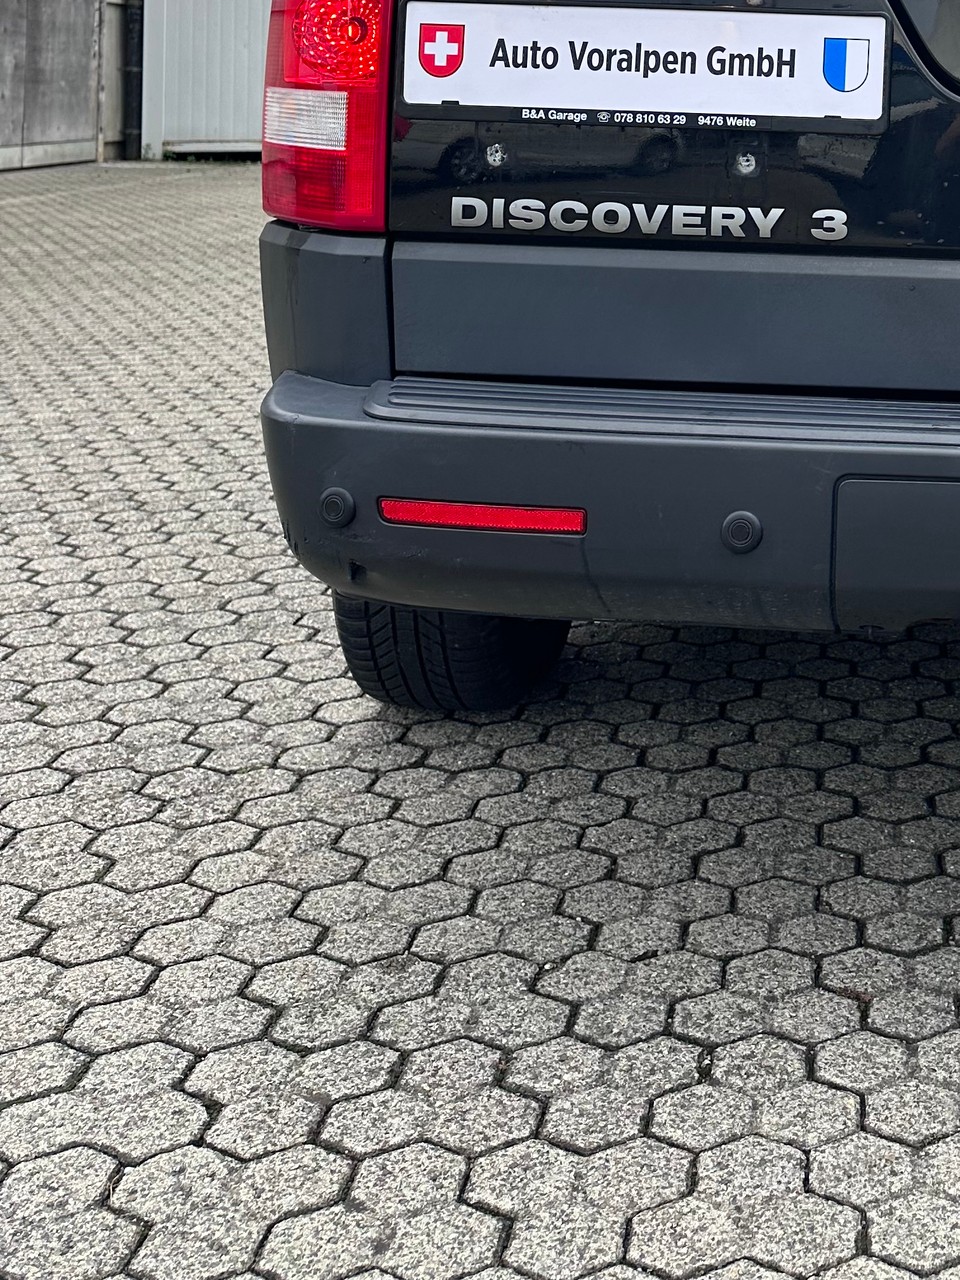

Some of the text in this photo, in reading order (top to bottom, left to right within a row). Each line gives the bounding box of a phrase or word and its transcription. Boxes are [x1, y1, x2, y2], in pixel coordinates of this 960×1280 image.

[489, 38, 796, 78] Auto Voralpen GmbH
[521, 109, 757, 127] B&A Garage 078 810 63 29 9476 Weite
[451, 196, 848, 241] DISCOVERY 3
